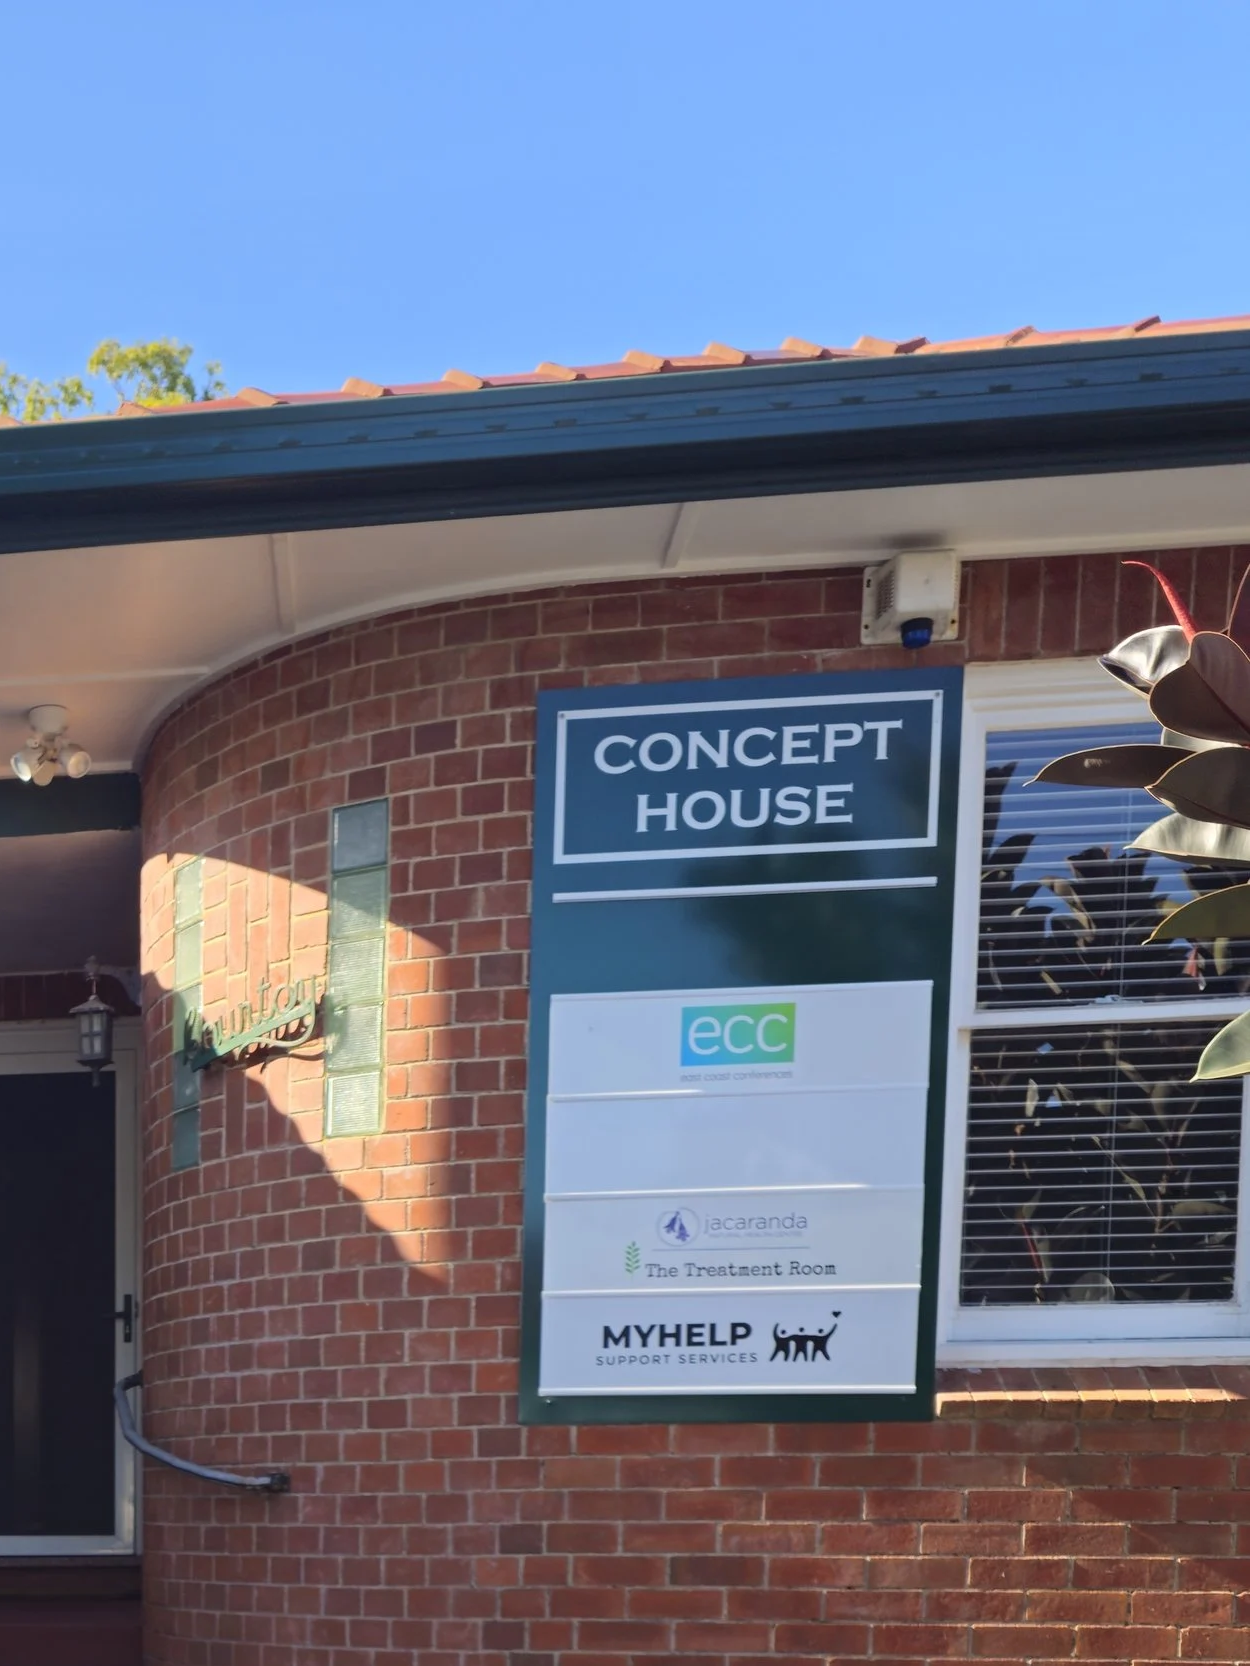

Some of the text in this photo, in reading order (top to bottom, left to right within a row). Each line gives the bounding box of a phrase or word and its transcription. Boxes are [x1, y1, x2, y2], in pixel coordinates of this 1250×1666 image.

[594, 719, 903, 775] CONCEPT
[635, 783, 854, 833] HOUSE
[688, 1013, 789, 1055] ecc
[704, 1212, 807, 1234] jacaranda
[645, 1260, 837, 1278] The Treatment Room
[602, 1321, 752, 1349] MYHELP
[595, 1351, 759, 1366] SUPPORT SERVICES
